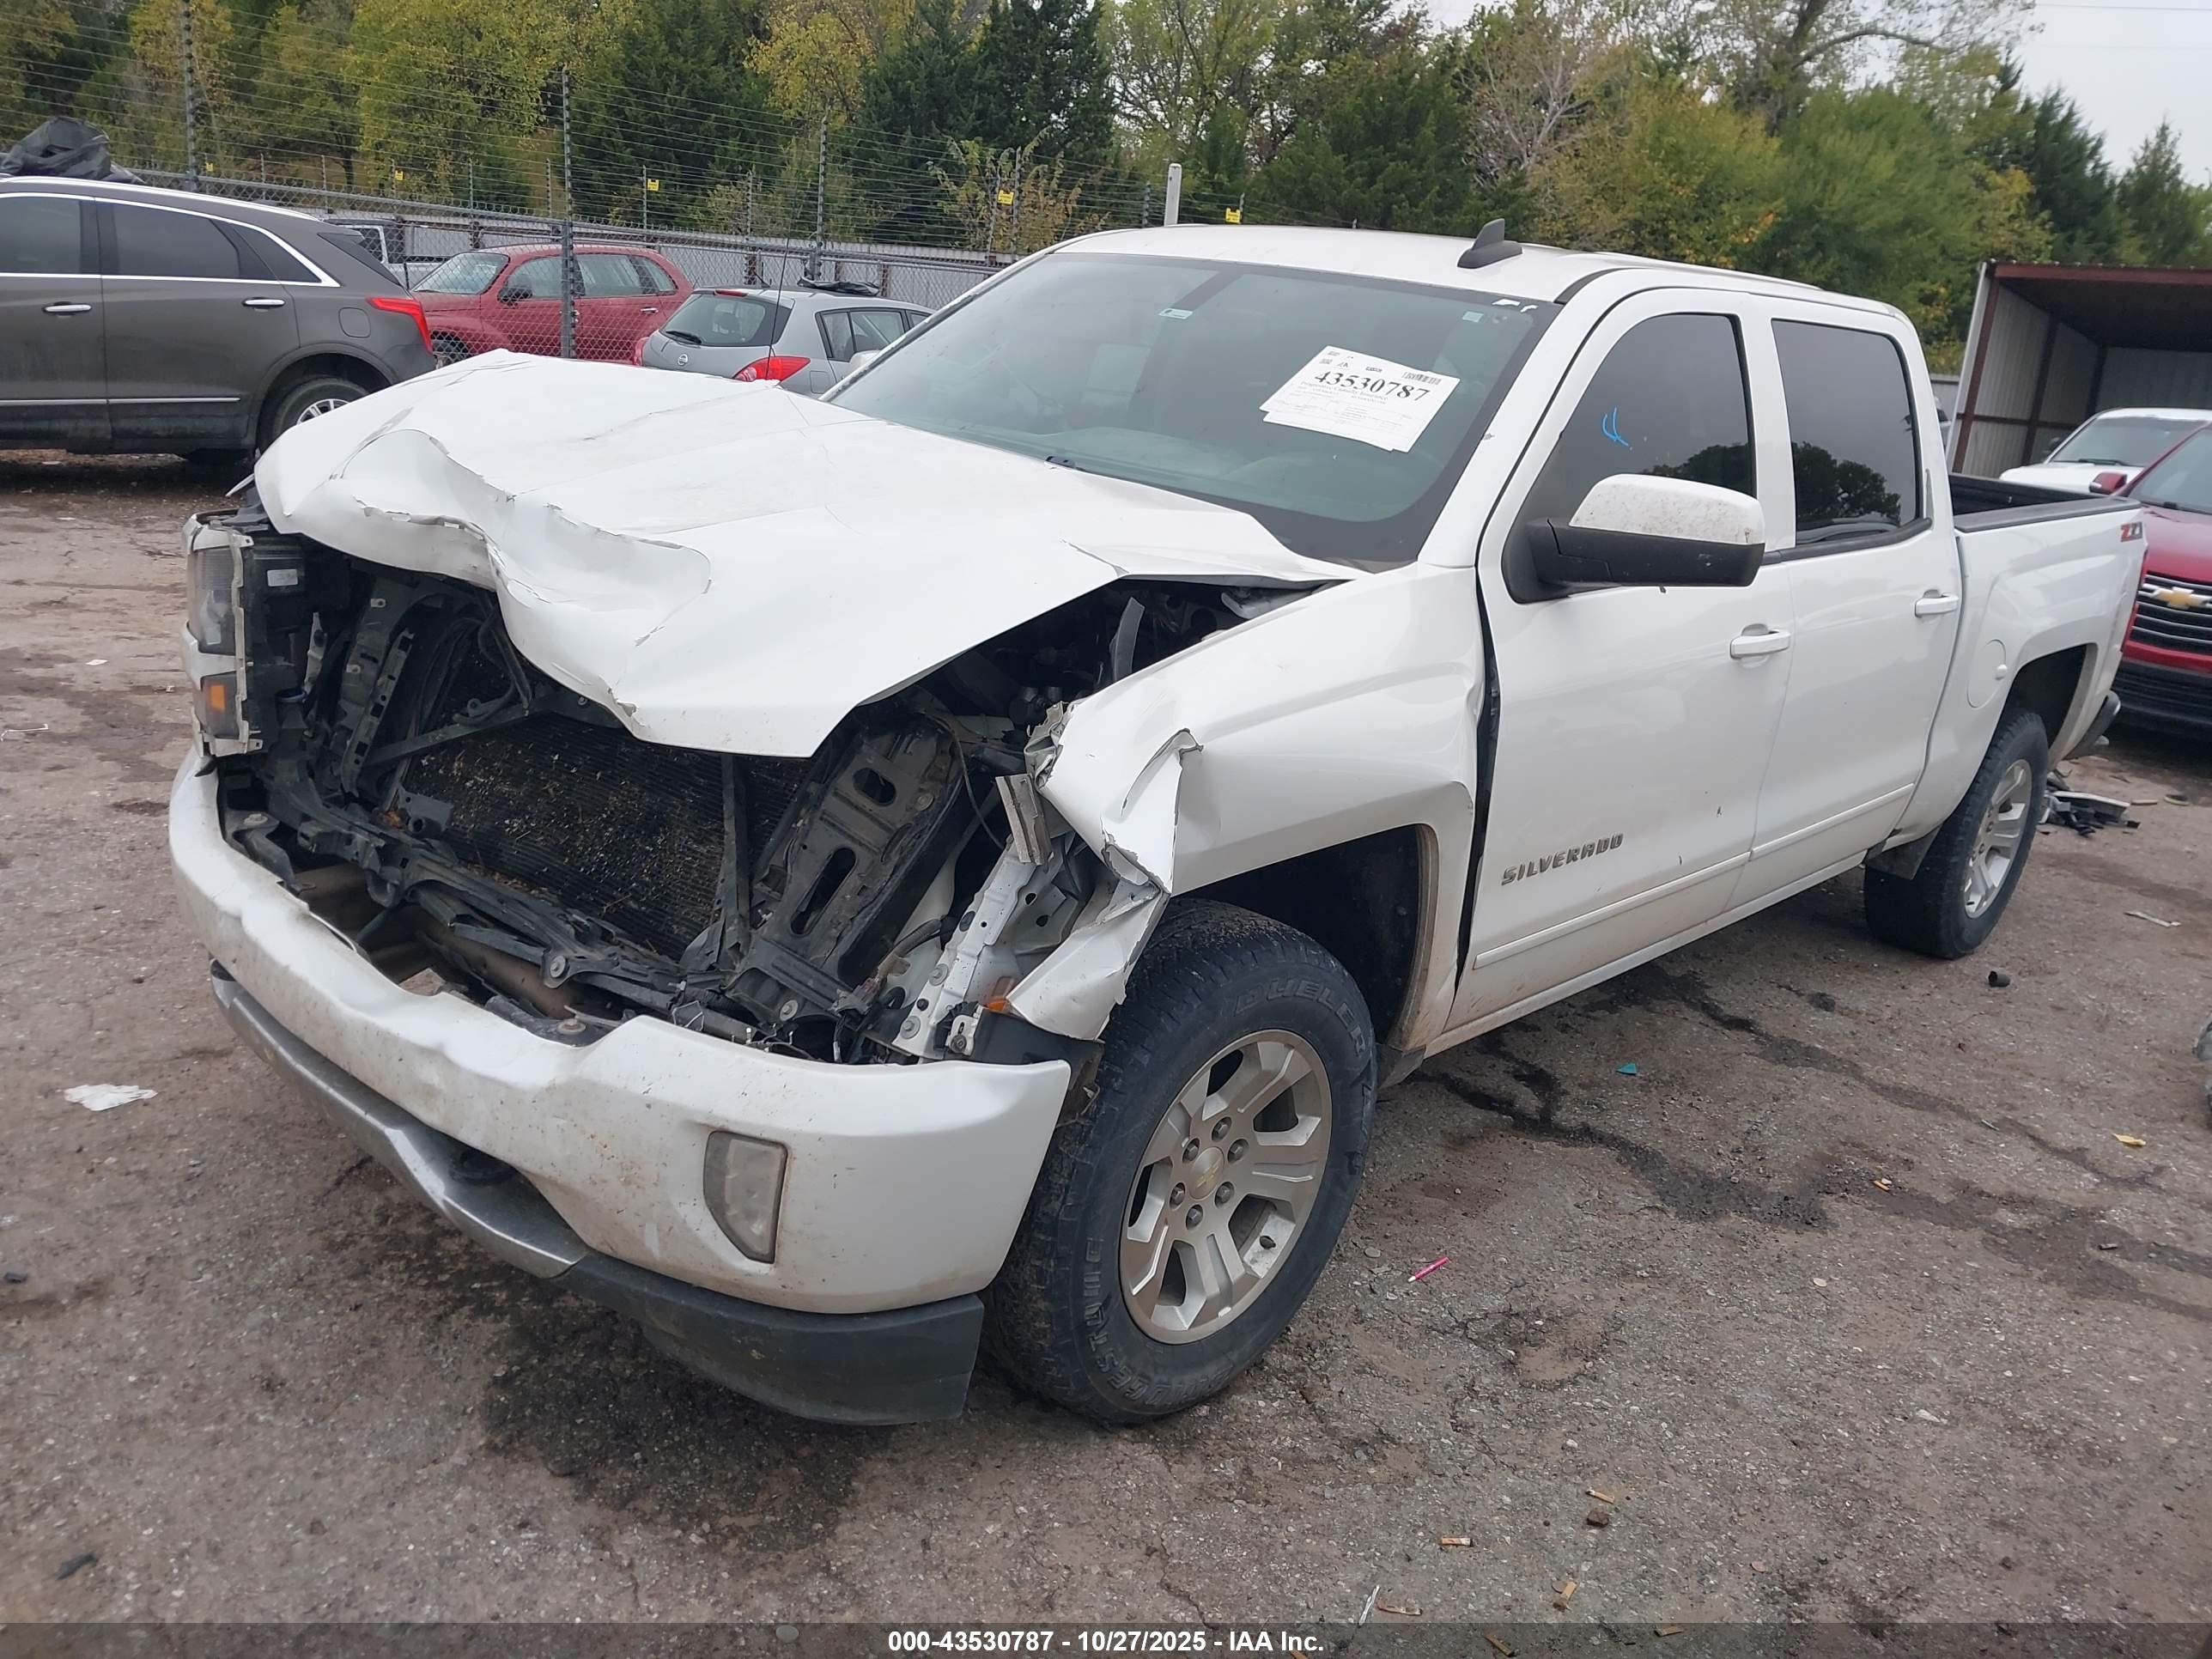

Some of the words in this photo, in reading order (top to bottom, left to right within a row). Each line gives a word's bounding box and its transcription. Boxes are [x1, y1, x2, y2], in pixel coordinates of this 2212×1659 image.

[1315, 370, 1431, 402] 43530787
[1501, 833, 1625, 886] SILVERADO
[1233, 979, 1366, 1057] DUELER
